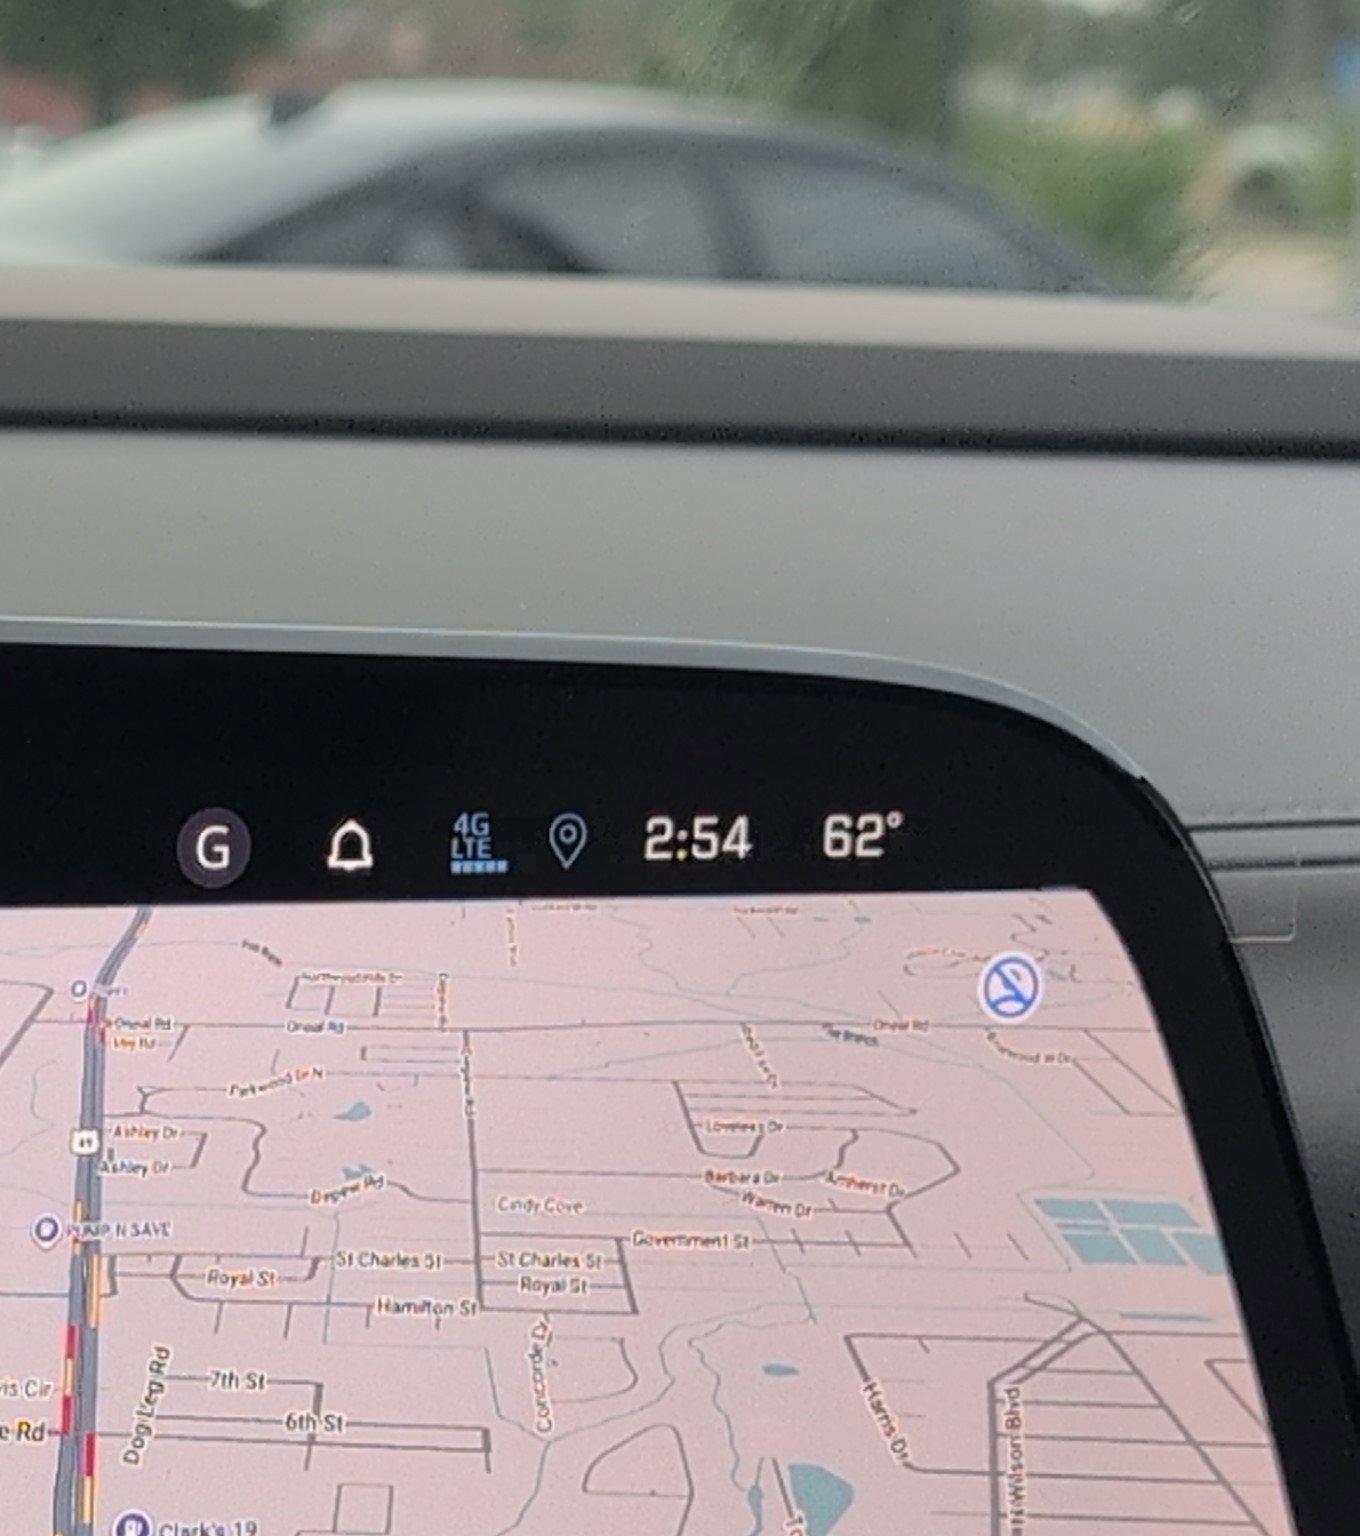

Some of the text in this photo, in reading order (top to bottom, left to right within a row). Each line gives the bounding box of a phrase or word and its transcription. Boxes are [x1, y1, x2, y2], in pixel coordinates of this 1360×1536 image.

[453, 811, 490, 836] 4G
[644, 814, 753, 861] 2:54
[823, 810, 905, 859] 62°
[197, 826, 229, 868] G
[450, 836, 492, 859] LTE
[327, 1021, 345, 1034] Rd
[112, 1126, 179, 1142] Ashley Dr
[767, 1120, 784, 1133] Dr
[99, 1160, 170, 1178] Ashley Dr
[704, 1169, 781, 1186] Barbara Dr
[362, 1173, 385, 1191] Rd
[826, 1169, 888, 1198] Amherst
[497, 1198, 584, 1216] Cindy Cove
[741, 1190, 813, 1219] Warren Dr
[114, 1222, 128, 1237] N
[131, 1221, 172, 1237] SAVE
[632, 1231, 751, 1249] Government St
[335, 1252, 442, 1269] St Charles St
[496, 1252, 603, 1269] St Charles St
[206, 1270, 277, 1290] Royal St
[519, 1278, 590, 1297] Royal St
[377, 1297, 479, 1319] Hamilton St
[209, 1370, 267, 1391] 7th St
[528, 1320, 553, 1433] Concorde Dr
[23, 1379, 53, 1398] Cir
[123, 1346, 170, 1465] Dog Leg Rd
[1003, 1386, 1023, 1431] Blvd
[15, 1420, 46, 1443] Rd
[285, 1412, 345, 1433] 6th St
[862, 1379, 910, 1464] Harris Dr
[1007, 1435, 1026, 1507] Wilson
